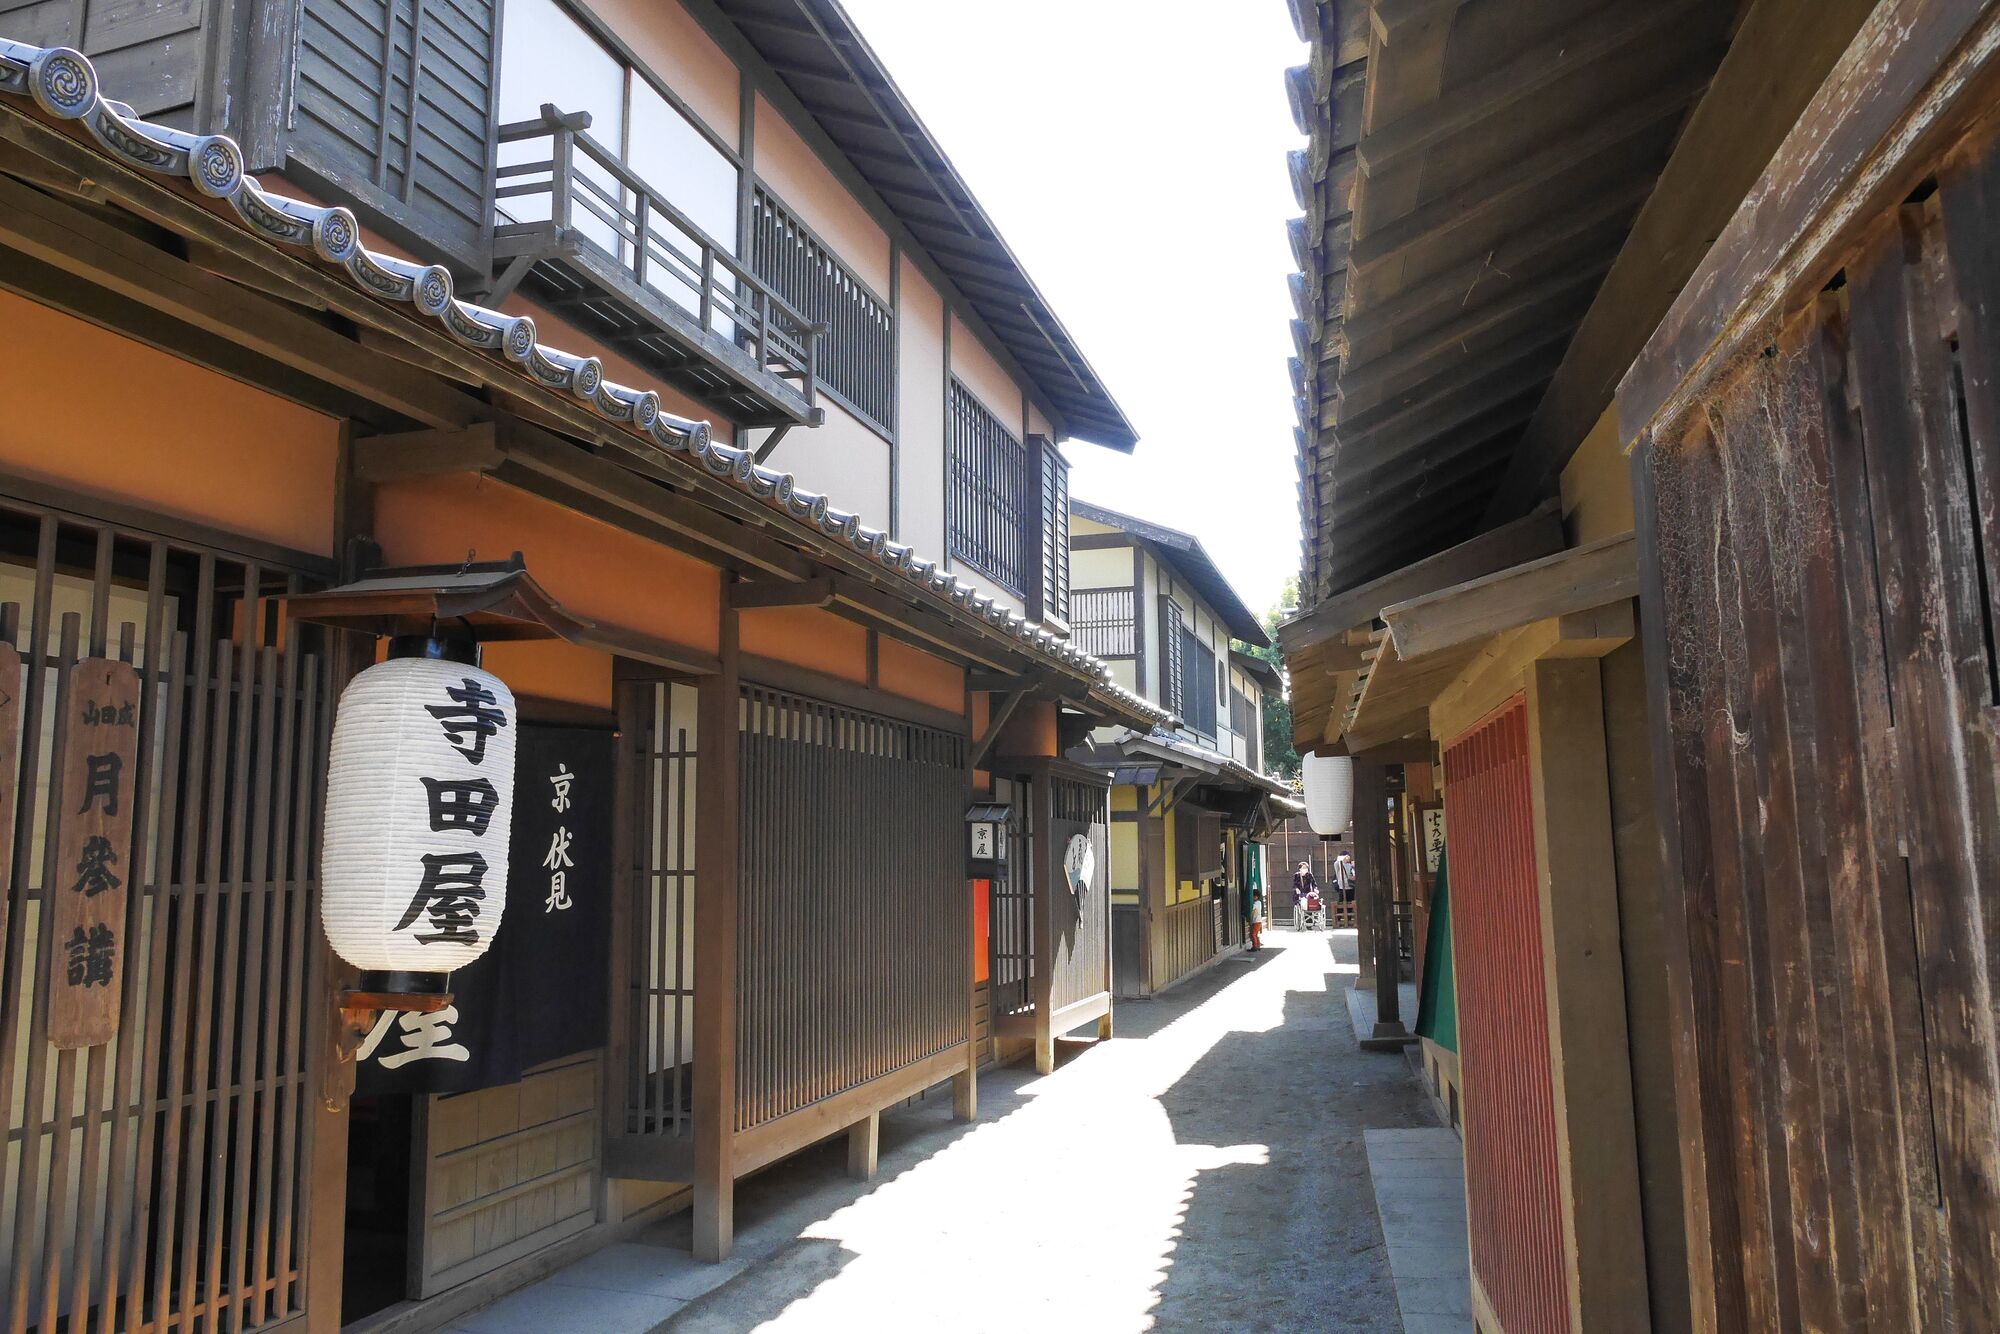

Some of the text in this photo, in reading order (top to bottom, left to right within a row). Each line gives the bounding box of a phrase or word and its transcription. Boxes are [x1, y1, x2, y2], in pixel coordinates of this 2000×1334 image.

[392, 678, 508, 946] 寺田屋
[976, 827, 988, 856] 京屋
